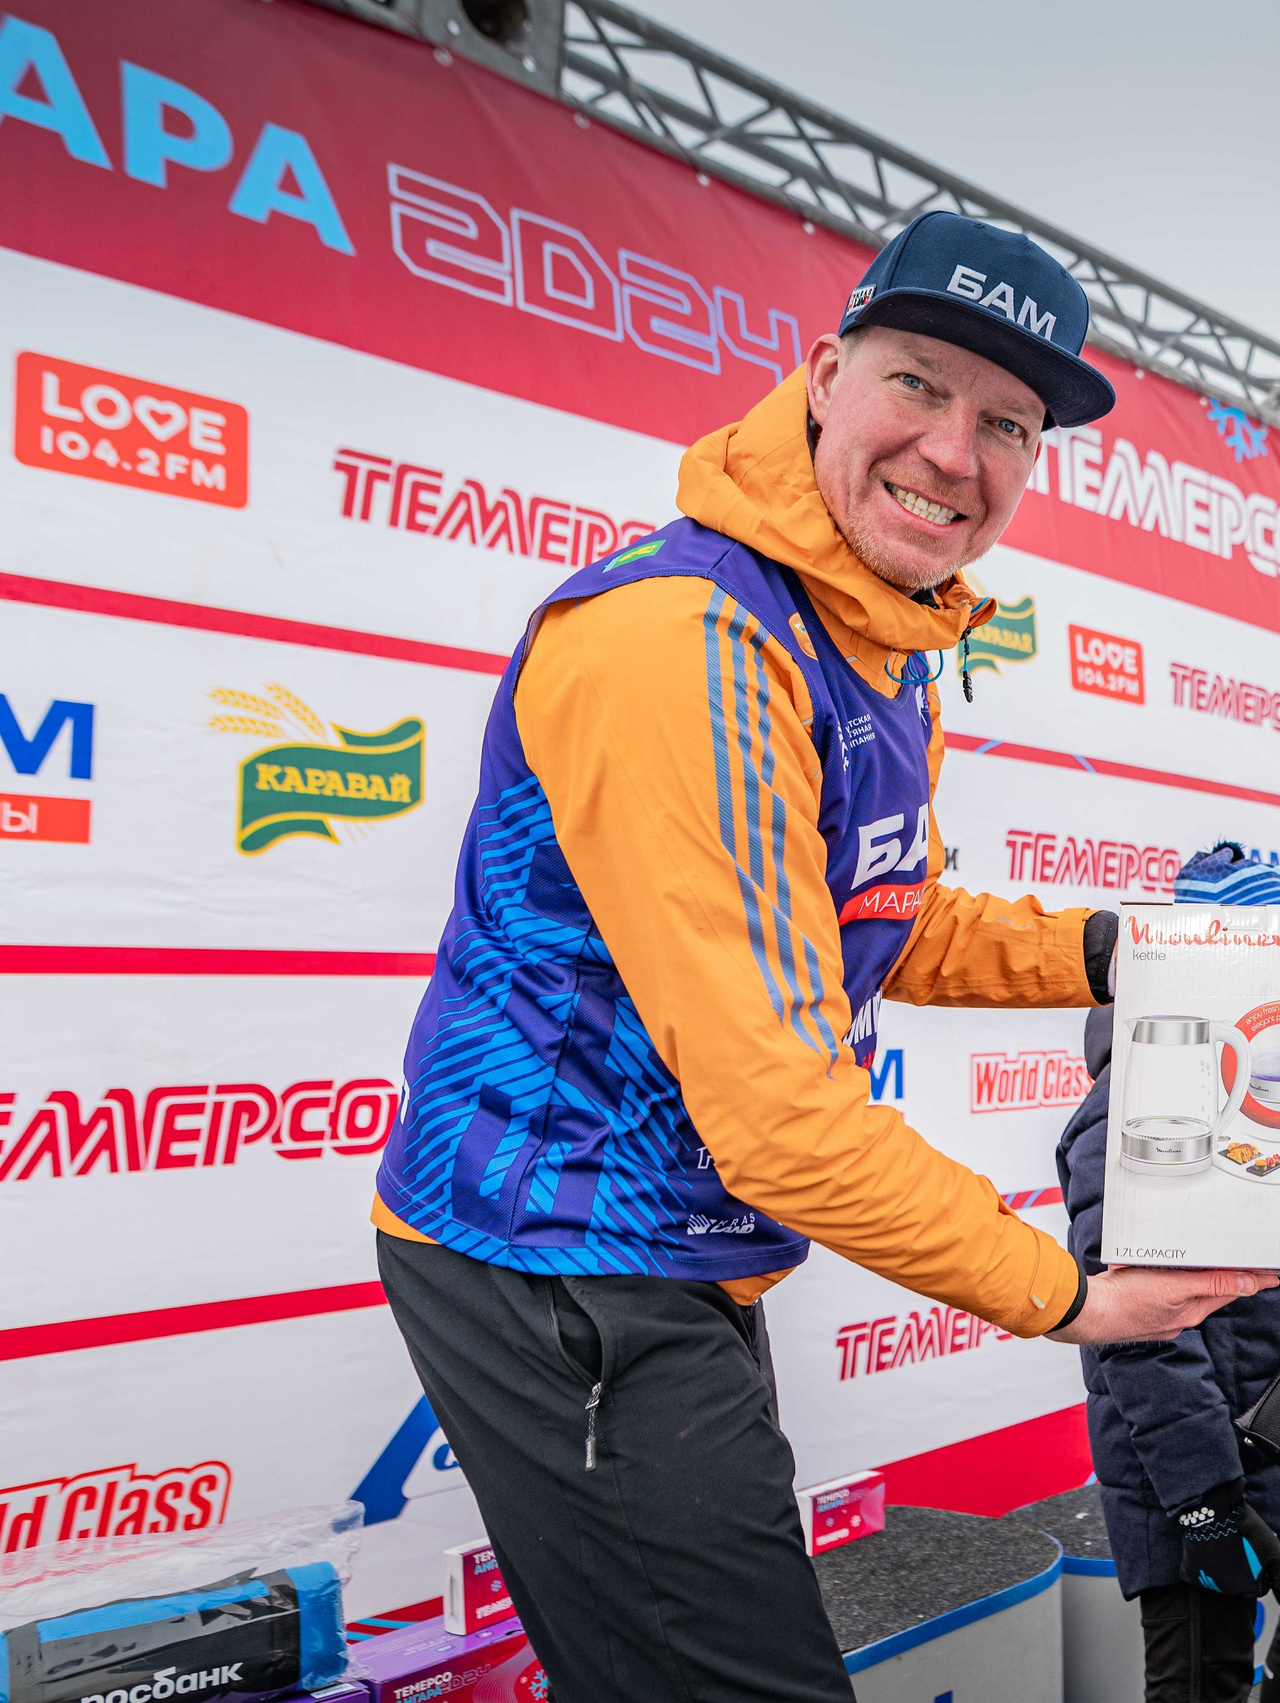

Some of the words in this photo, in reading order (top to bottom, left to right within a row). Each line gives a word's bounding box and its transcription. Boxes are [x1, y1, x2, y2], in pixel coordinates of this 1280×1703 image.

[946, 264, 1057, 341] БАМ
[39, 424, 229, 493] 104.2FM
[255, 763, 413, 804] КАРАВАЙ
[1005, 829, 1182, 893] ТЕМЕРСО
[1132, 949, 1167, 961] kettle
[1245, 1011, 1263, 1025] enjoy
[1262, 1004, 1280, 1015] fresh
[1250, 1015, 1276, 1032] elegant
[975, 1060, 1040, 1105] World
[1115, 1247, 1134, 1257] 1.7L
[1136, 1248, 1187, 1259] CAPACITY
[835, 1306, 1014, 1382] ТЕМЕР
[57, 1474, 218, 1546] Class
[393, 1671, 454, 1699] ТЕМЕРСО
